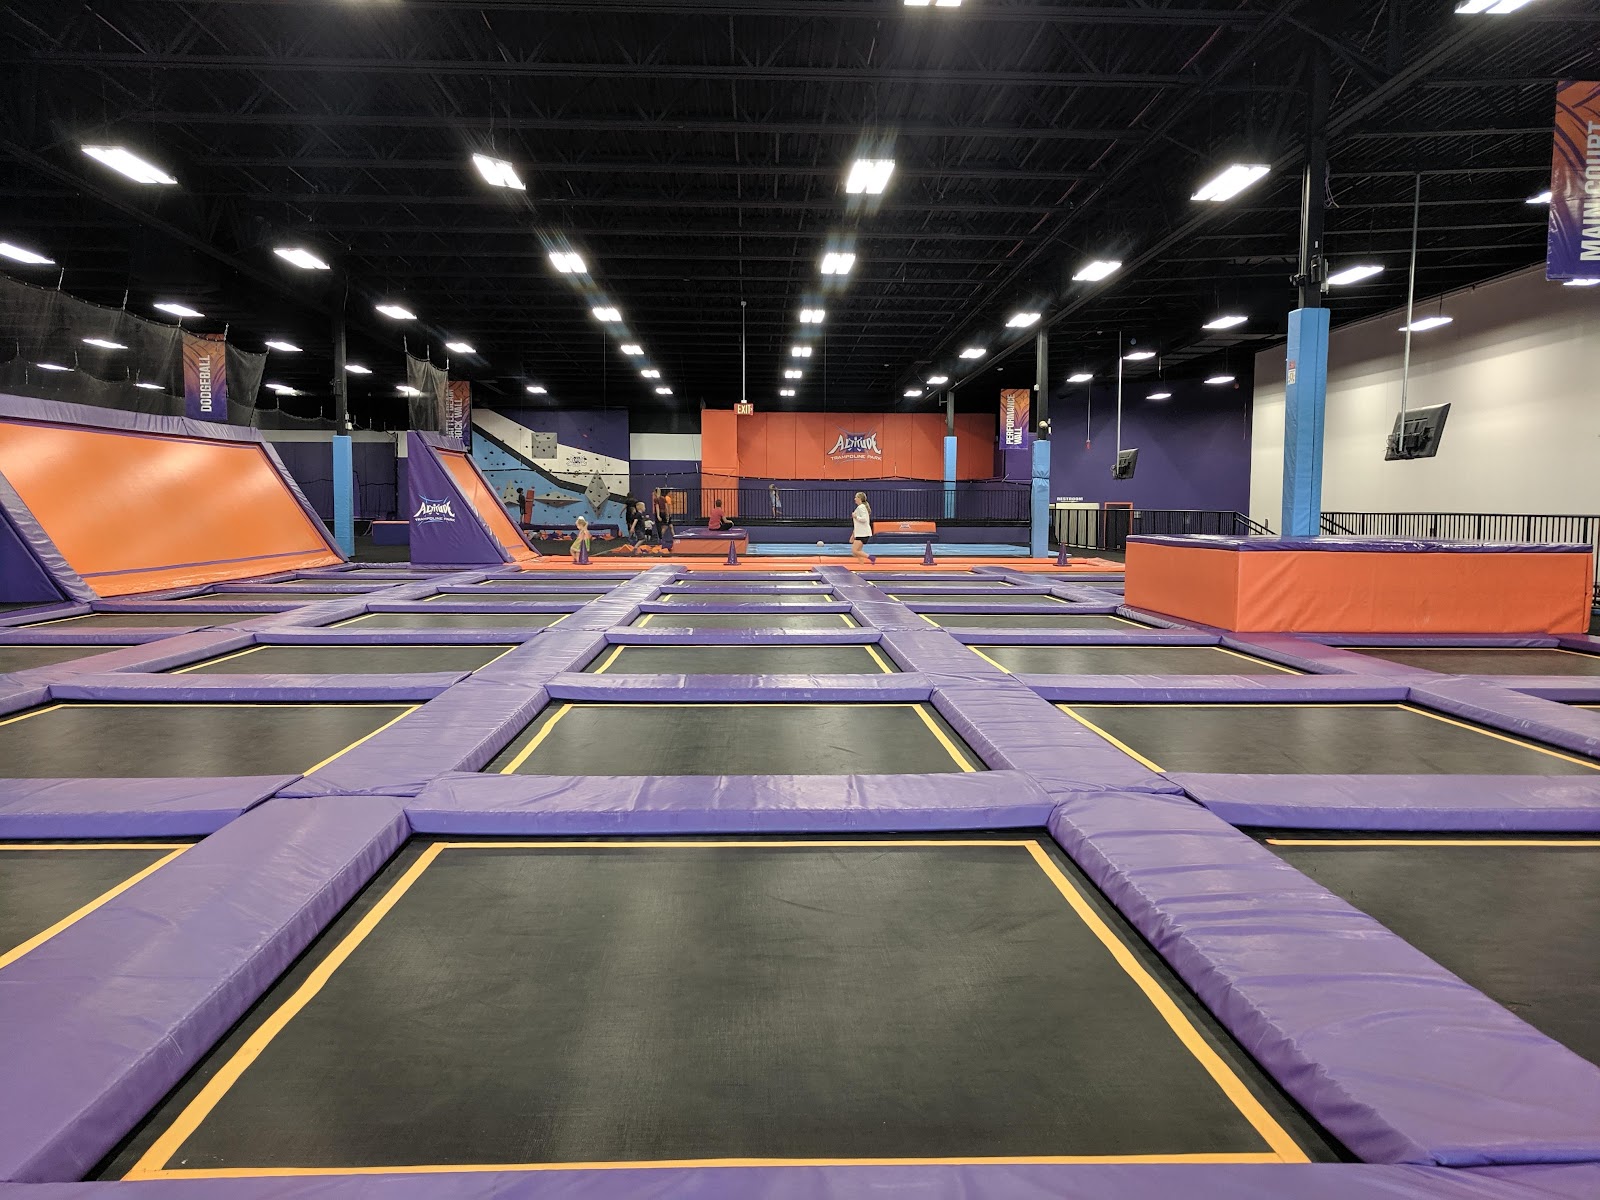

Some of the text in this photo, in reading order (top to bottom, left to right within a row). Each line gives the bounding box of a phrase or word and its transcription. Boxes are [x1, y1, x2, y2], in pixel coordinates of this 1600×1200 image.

[1580, 200, 1600, 261] MAIN
[199, 355, 212, 412] DODGEBALL
[454, 398, 463, 440] ROCK WALL
[737, 404, 751, 415] EXIT
[1006, 394, 1014, 444] PERFORMANCE
[827, 433, 882, 455] ALTITUDE
[1014, 427, 1022, 444] WALL
[413, 500, 456, 517] ALTITUDE
